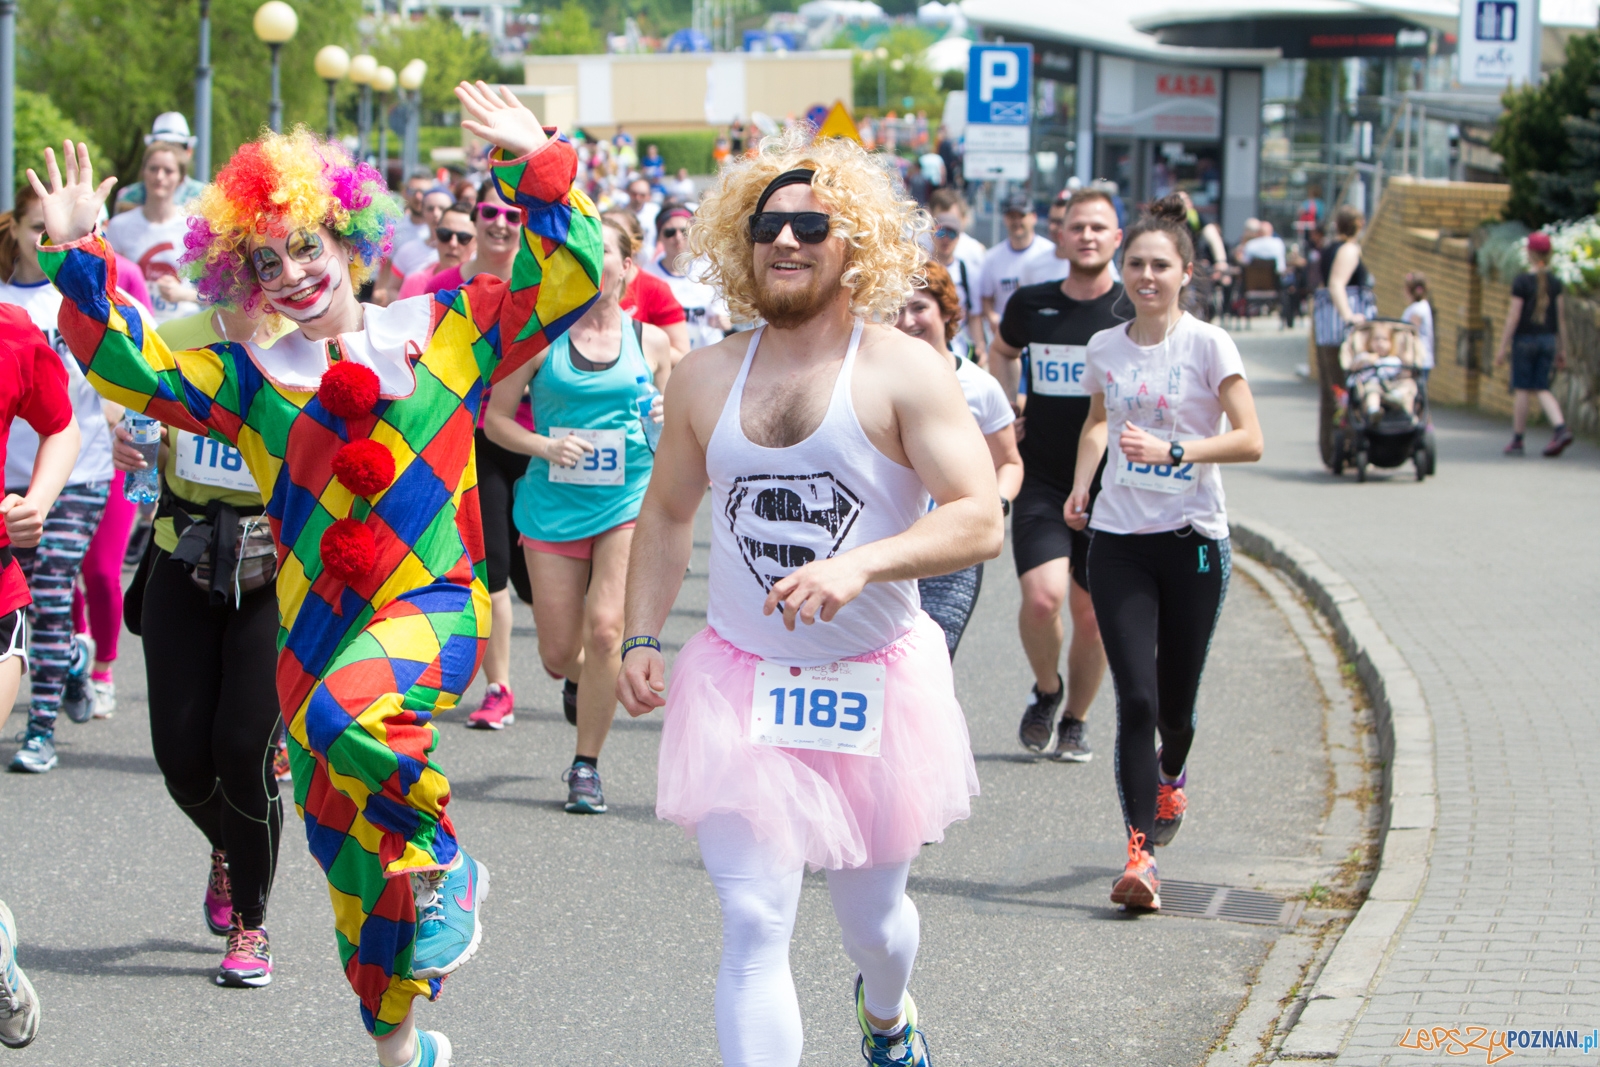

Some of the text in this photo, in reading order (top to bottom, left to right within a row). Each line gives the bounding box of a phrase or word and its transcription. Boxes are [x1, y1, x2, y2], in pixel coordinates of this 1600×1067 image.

[980, 50, 1020, 103] P
[1156, 73, 1216, 97] KASA
[1036, 360, 1085, 383] 1616
[559, 447, 617, 471] 33
[769, 687, 868, 732] 1183
